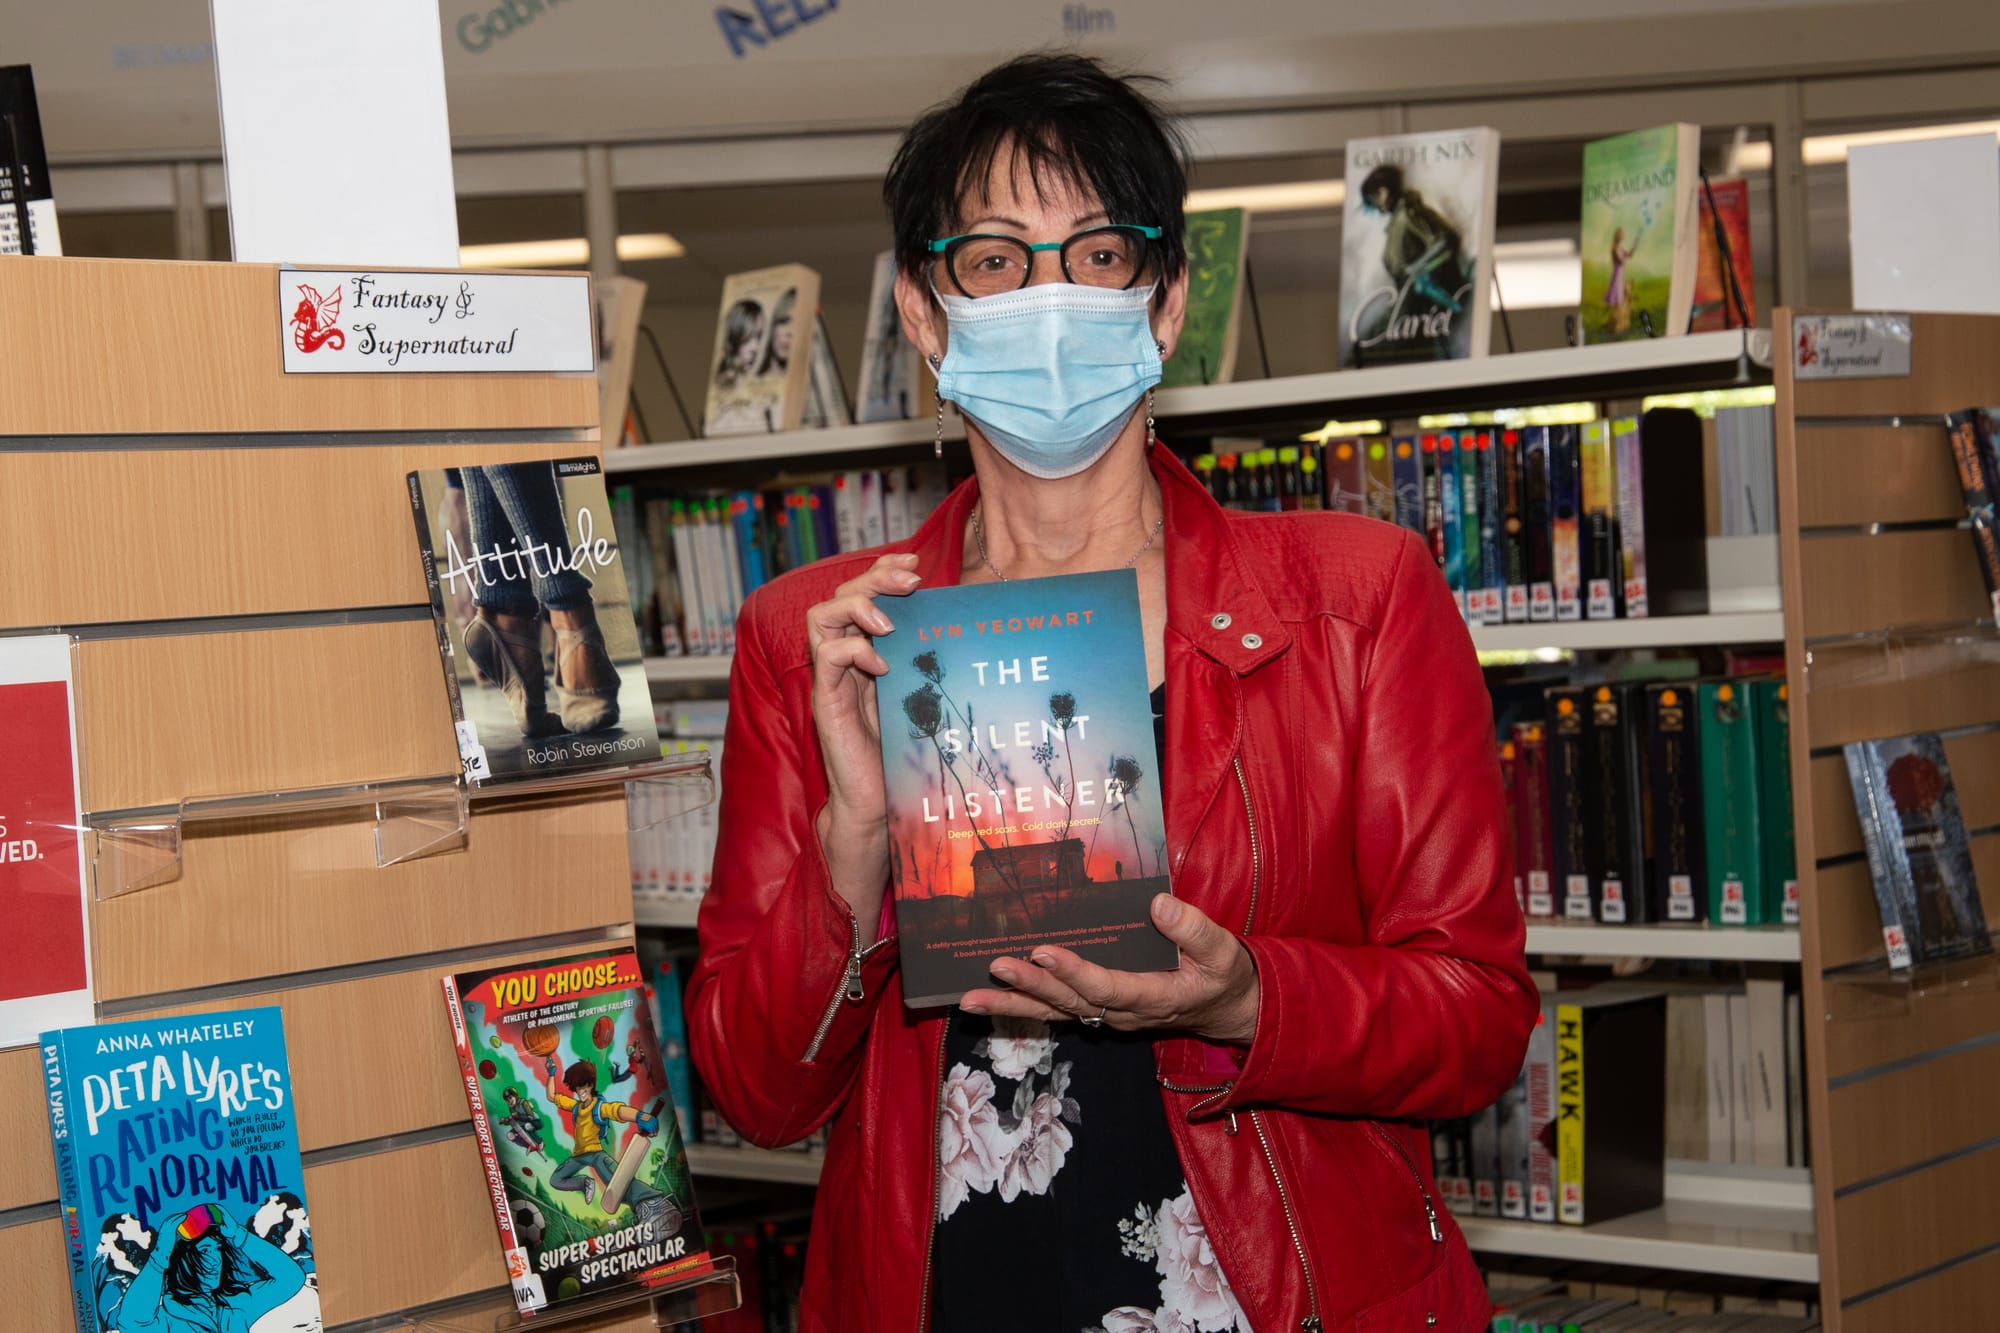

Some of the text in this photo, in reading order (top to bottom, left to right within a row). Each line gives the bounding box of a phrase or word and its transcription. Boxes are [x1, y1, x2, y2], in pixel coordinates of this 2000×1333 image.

[1435, 139, 1476, 161] NIX
[350, 274, 477, 324] Fantasy &
[352, 322, 519, 366] Supernatural
[422, 549, 438, 588] Attitude
[440, 507, 617, 600] Attitude
[919, 610, 1094, 641] LYN YEOWART
[972, 656, 1050, 687] THE
[527, 736, 646, 766] Robin Stevenson
[944, 715, 1090, 753] SILENT
[922, 778, 1125, 823] LISTENER
[948, 829, 974, 840] Deep
[994, 825, 1019, 835] scars.
[1022, 820, 1044, 831] Cold
[1046, 818, 1068, 829] dark
[1069, 816, 1103, 827] secrets.
[952, 939, 979, 947] wrought
[1050, 928, 1087, 937] remarkable
[1102, 924, 1125, 932] literary
[953, 951, 959, 959] A
[960, 950, 977, 958] book
[991, 946, 1013, 954] should
[447, 985, 455, 1002] YOU
[491, 962, 637, 1009] YOU CHOOSE...
[503, 1002, 580, 1025] ATHLETE OF THE CENTURY
[528, 999, 634, 1029] OR PHENOMENAL SPORTING FAILURE!
[96, 1020, 255, 1055] ANNA WHATELEY
[1560, 1020, 1580, 1121] HAWK
[82, 1050, 284, 1136] PETA LYRE'S
[228, 1112, 279, 1128] WHICH RULES
[230, 1121, 286, 1136] DO YOU FOLLOW?
[230, 1134, 262, 1149] WHICH DO
[466, 1076, 510, 1231] SUPER SPORTS SPECTACULAR
[44, 1045, 61, 1088] PETA
[65, 1206, 85, 1276] NORMAL
[133, 1153, 288, 1233] NORMAL
[539, 1222, 654, 1272] SUPER SPORTS
[581, 1236, 686, 1284] SPECTACULAR
[515, 1286, 536, 1303] IVA
